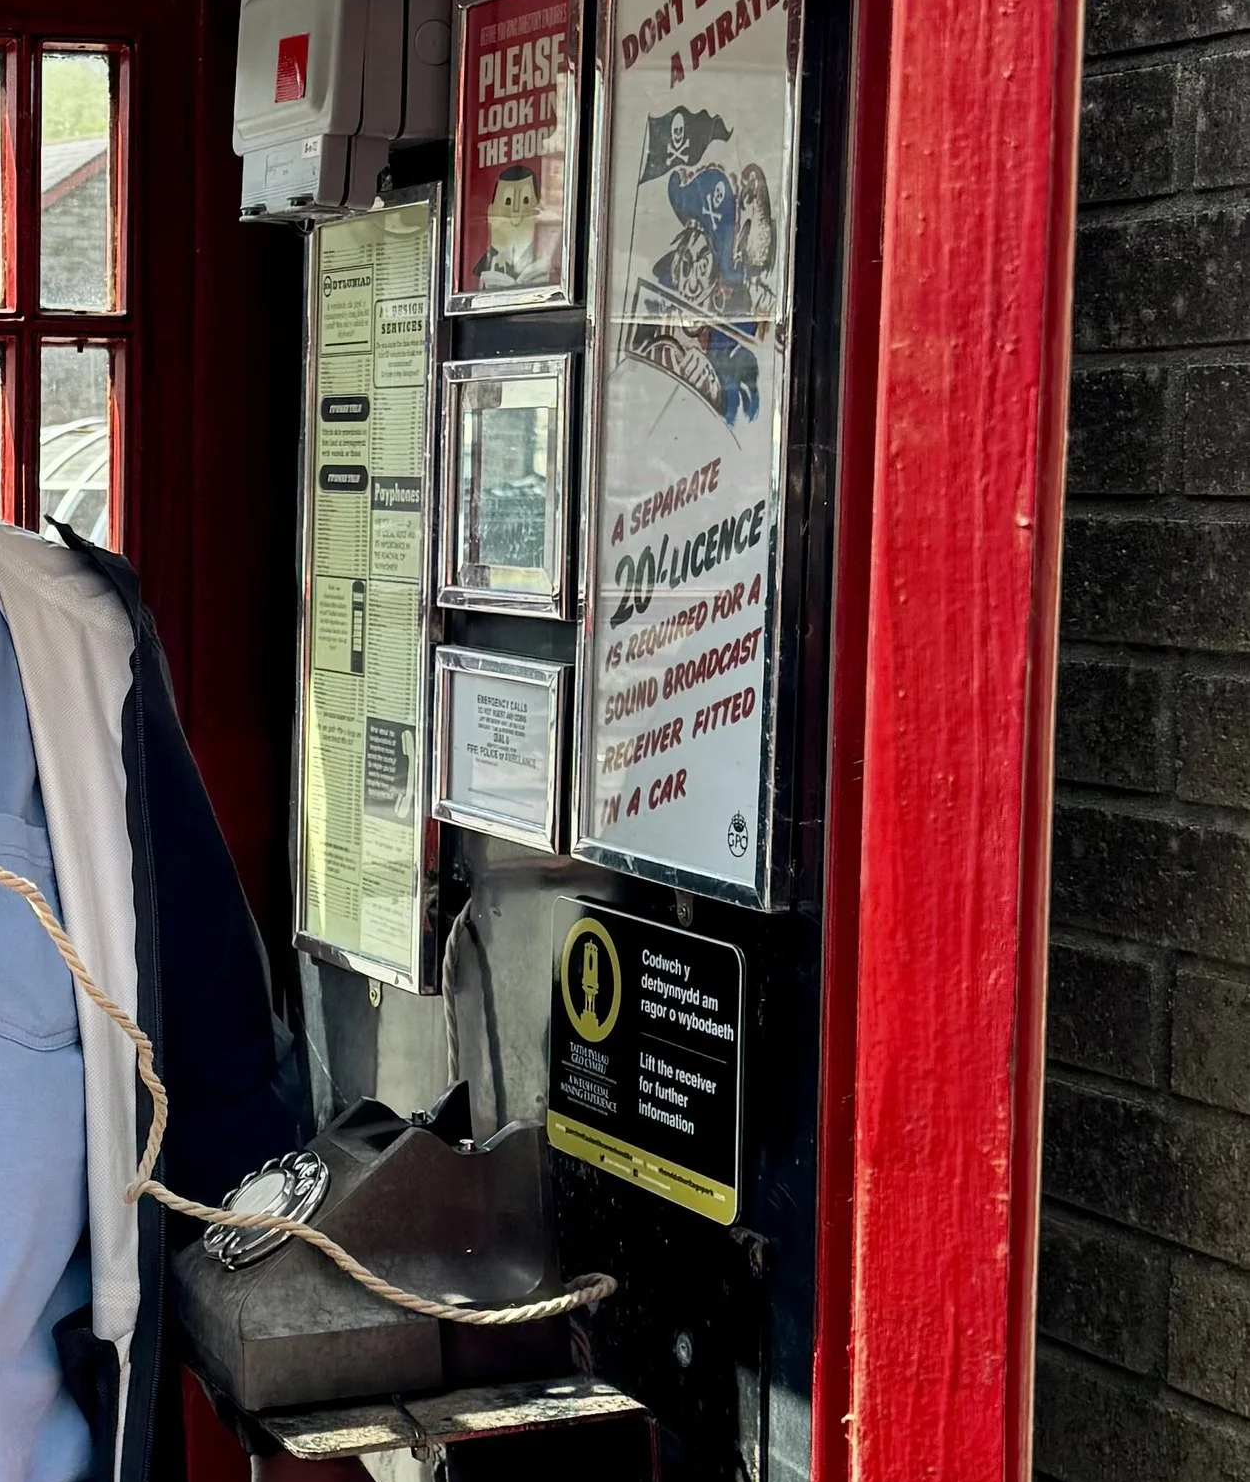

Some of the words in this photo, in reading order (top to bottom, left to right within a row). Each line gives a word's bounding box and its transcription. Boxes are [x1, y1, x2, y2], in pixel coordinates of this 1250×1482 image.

[479, 32, 565, 102] PLEASE
[669, 51, 685, 89] A
[478, 96, 534, 135] LOOK
[477, 136, 508, 168] THE
[381, 320, 423, 334] SERVICES
[374, 482, 420, 507] Payphones
[611, 513, 624, 547] A
[630, 457, 721, 535] SEPARATE
[669, 499, 766, 589] LICENCE
[605, 641, 623, 672] IS
[625, 600, 707, 663] REQUIRED
[711, 582, 745, 623] FOR
[747, 573, 761, 606] A
[605, 676, 658, 725] SOUND
[662, 626, 763, 700] BROADCAST
[602, 717, 684, 774] RECEIVER
[692, 686, 756, 739] FITTED
[601, 793, 621, 826] IN
[626, 786, 641, 817] A
[648, 768, 687, 810] CAR
[642, 949, 682, 976] Codwch
[684, 965, 691, 982] y
[641, 973, 700, 1005] derbynnydd
[702, 995, 719, 1012] am
[641, 999, 667, 1019] ragor
[669, 1008, 676, 1022] o
[678, 1011, 734, 1042] wybodaeth
[639, 1051, 656, 1071] Lift
[657, 1059, 673, 1079] the
[675, 1068, 717, 1095] receiver
[639, 1075, 653, 1094] for
[655, 1081, 689, 1108] further
[639, 1098, 695, 1136] information
